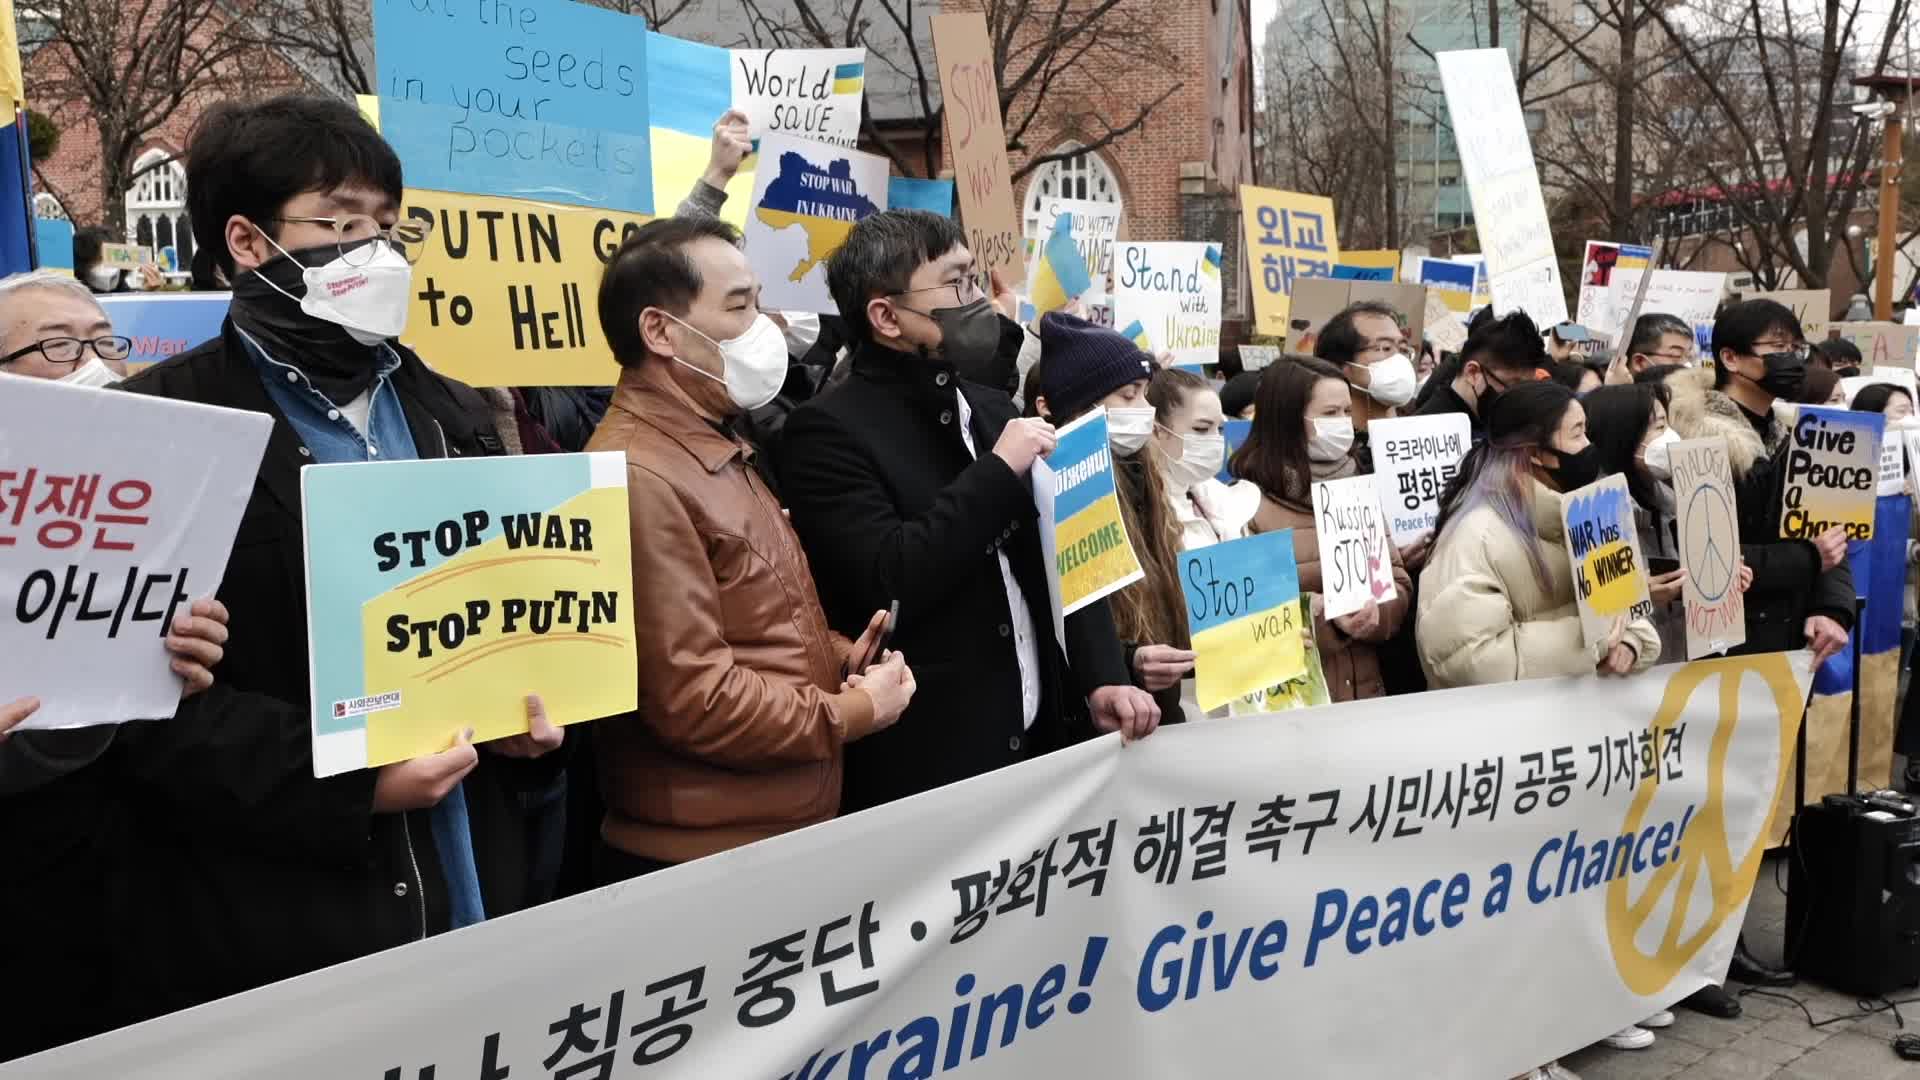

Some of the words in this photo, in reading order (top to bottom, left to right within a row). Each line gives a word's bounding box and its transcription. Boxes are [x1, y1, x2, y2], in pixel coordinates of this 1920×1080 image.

[391, 73, 428, 104] in
[451, 86, 551, 124] your
[951, 60, 994, 149] STOP
[449, 125, 635, 175] pockets
[800, 172, 830, 190] STOP
[831, 178, 853, 195] WAR
[796, 200, 810, 214] IN
[811, 201, 857, 222] UKRAINE
[1045, 204, 1084, 233] SND
[1088, 215, 1115, 232] WITH
[1256, 205, 1328, 252] 외교
[1121, 246, 1201, 294] Stand
[418, 278, 473, 326] to
[1180, 296, 1209, 314] with
[1386, 432, 1463, 465] 우크라이나에
[1794, 413, 1856, 455] Give
[1787, 449, 1873, 491] Peace
[0, 467, 152, 551] 전쟁은
[1785, 486, 1803, 509] a
[373, 510, 490, 572] STOP
[501, 512, 593, 551] WAR
[1395, 516, 1424, 533] Peace
[1568, 520, 1597, 559] WAR
[1597, 516, 1620, 545] has
[1783, 510, 1871, 540] Chace
[1593, 546, 1635, 587] WINNER
[16, 564, 189, 640] 아니다
[1687, 600, 1716, 641] NOT
[386, 600, 491, 659] STOP
[501, 590, 618, 634] PUTIN
[543, 966, 708, 1080] 침공
[734, 900, 880, 1029] 중단
[949, 819, 1118, 945] 평화적
[1133, 800, 1237, 885] 해결
[1245, 788, 1341, 864] 촉구
[1348, 756, 1504, 843] 시민사회
[1513, 746, 1578, 815] 공동
[1585, 722, 1688, 798] 기자회견
[775, 936, 1109, 1080] kraine!
[1136, 910, 1289, 1013] Give
[1303, 872, 1471, 969] Peace
[1483, 862, 1513, 919] a
[1526, 803, 1696, 905] Chance!
